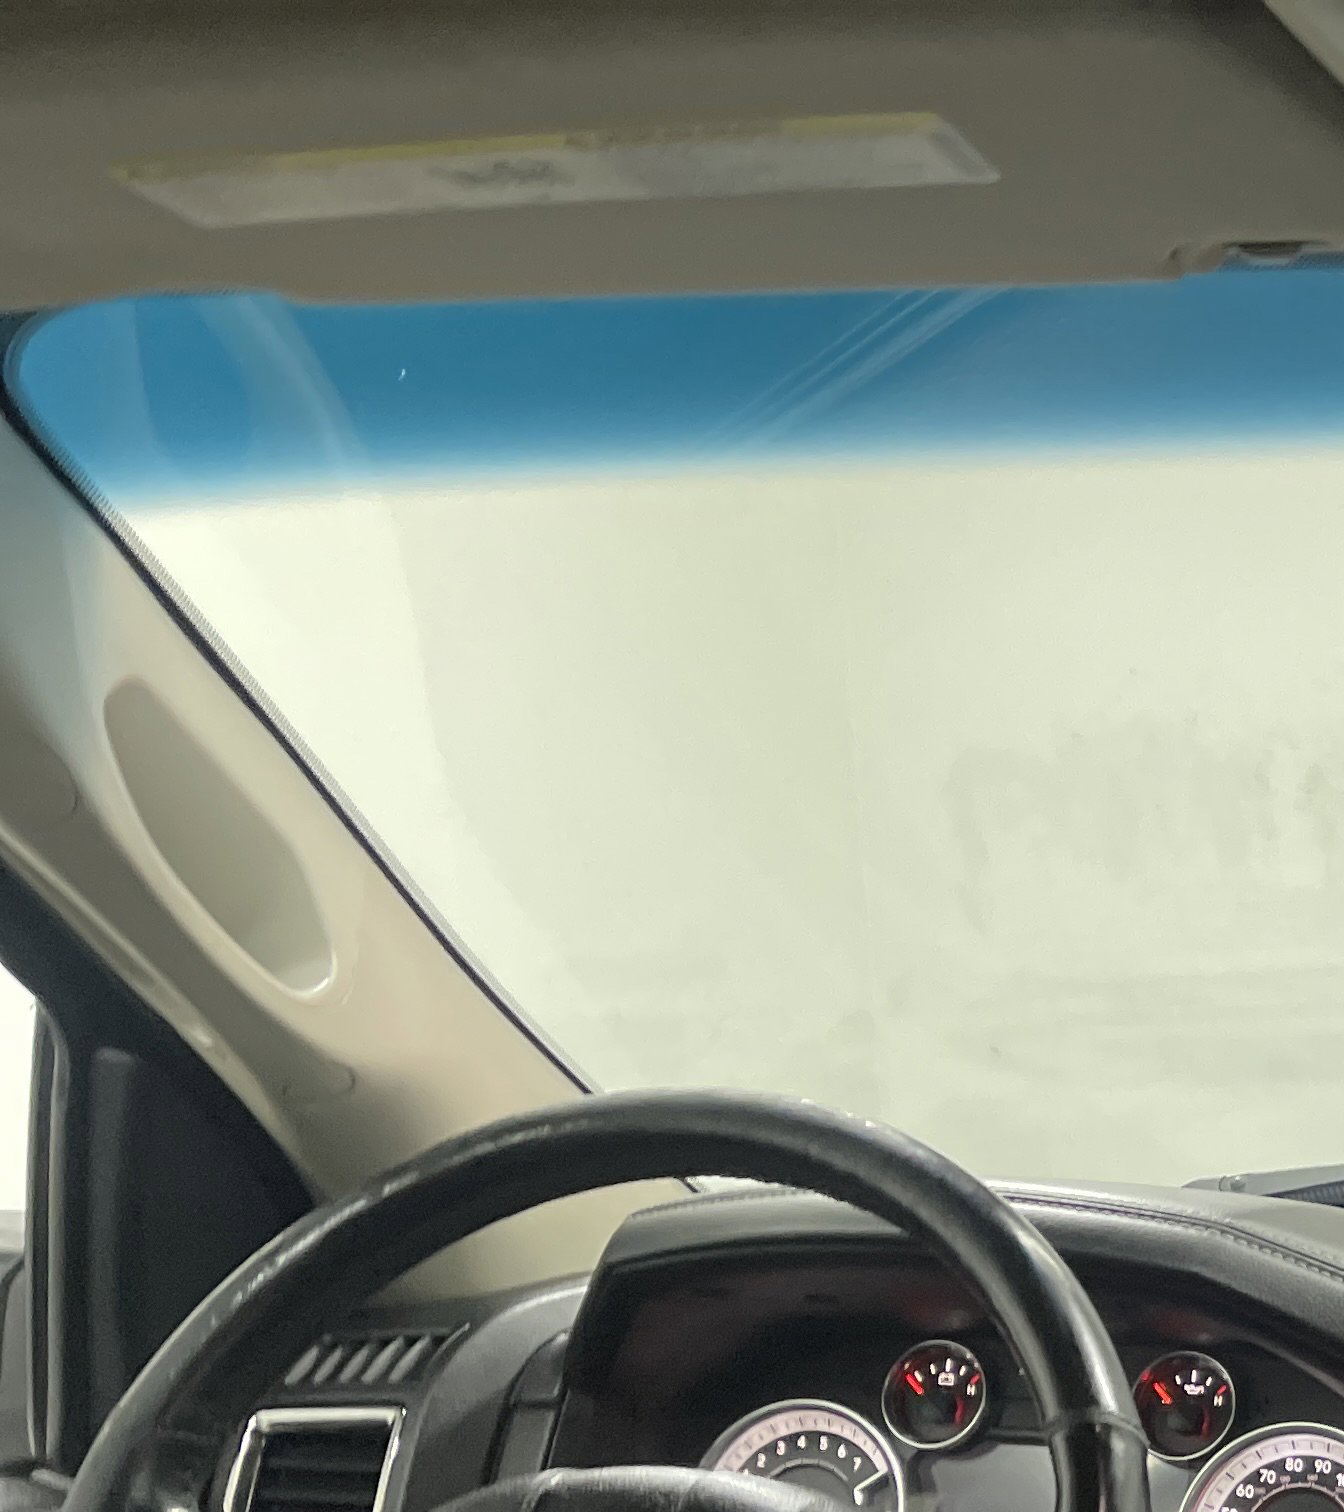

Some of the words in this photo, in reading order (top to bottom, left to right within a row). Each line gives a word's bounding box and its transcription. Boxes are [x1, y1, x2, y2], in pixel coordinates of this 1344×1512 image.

[1284, 1457, 1303, 1473] 80
[1314, 1459, 1332, 1474] 90
[1259, 1468, 1277, 1484] 70
[1235, 1484, 1255, 1499] 60
